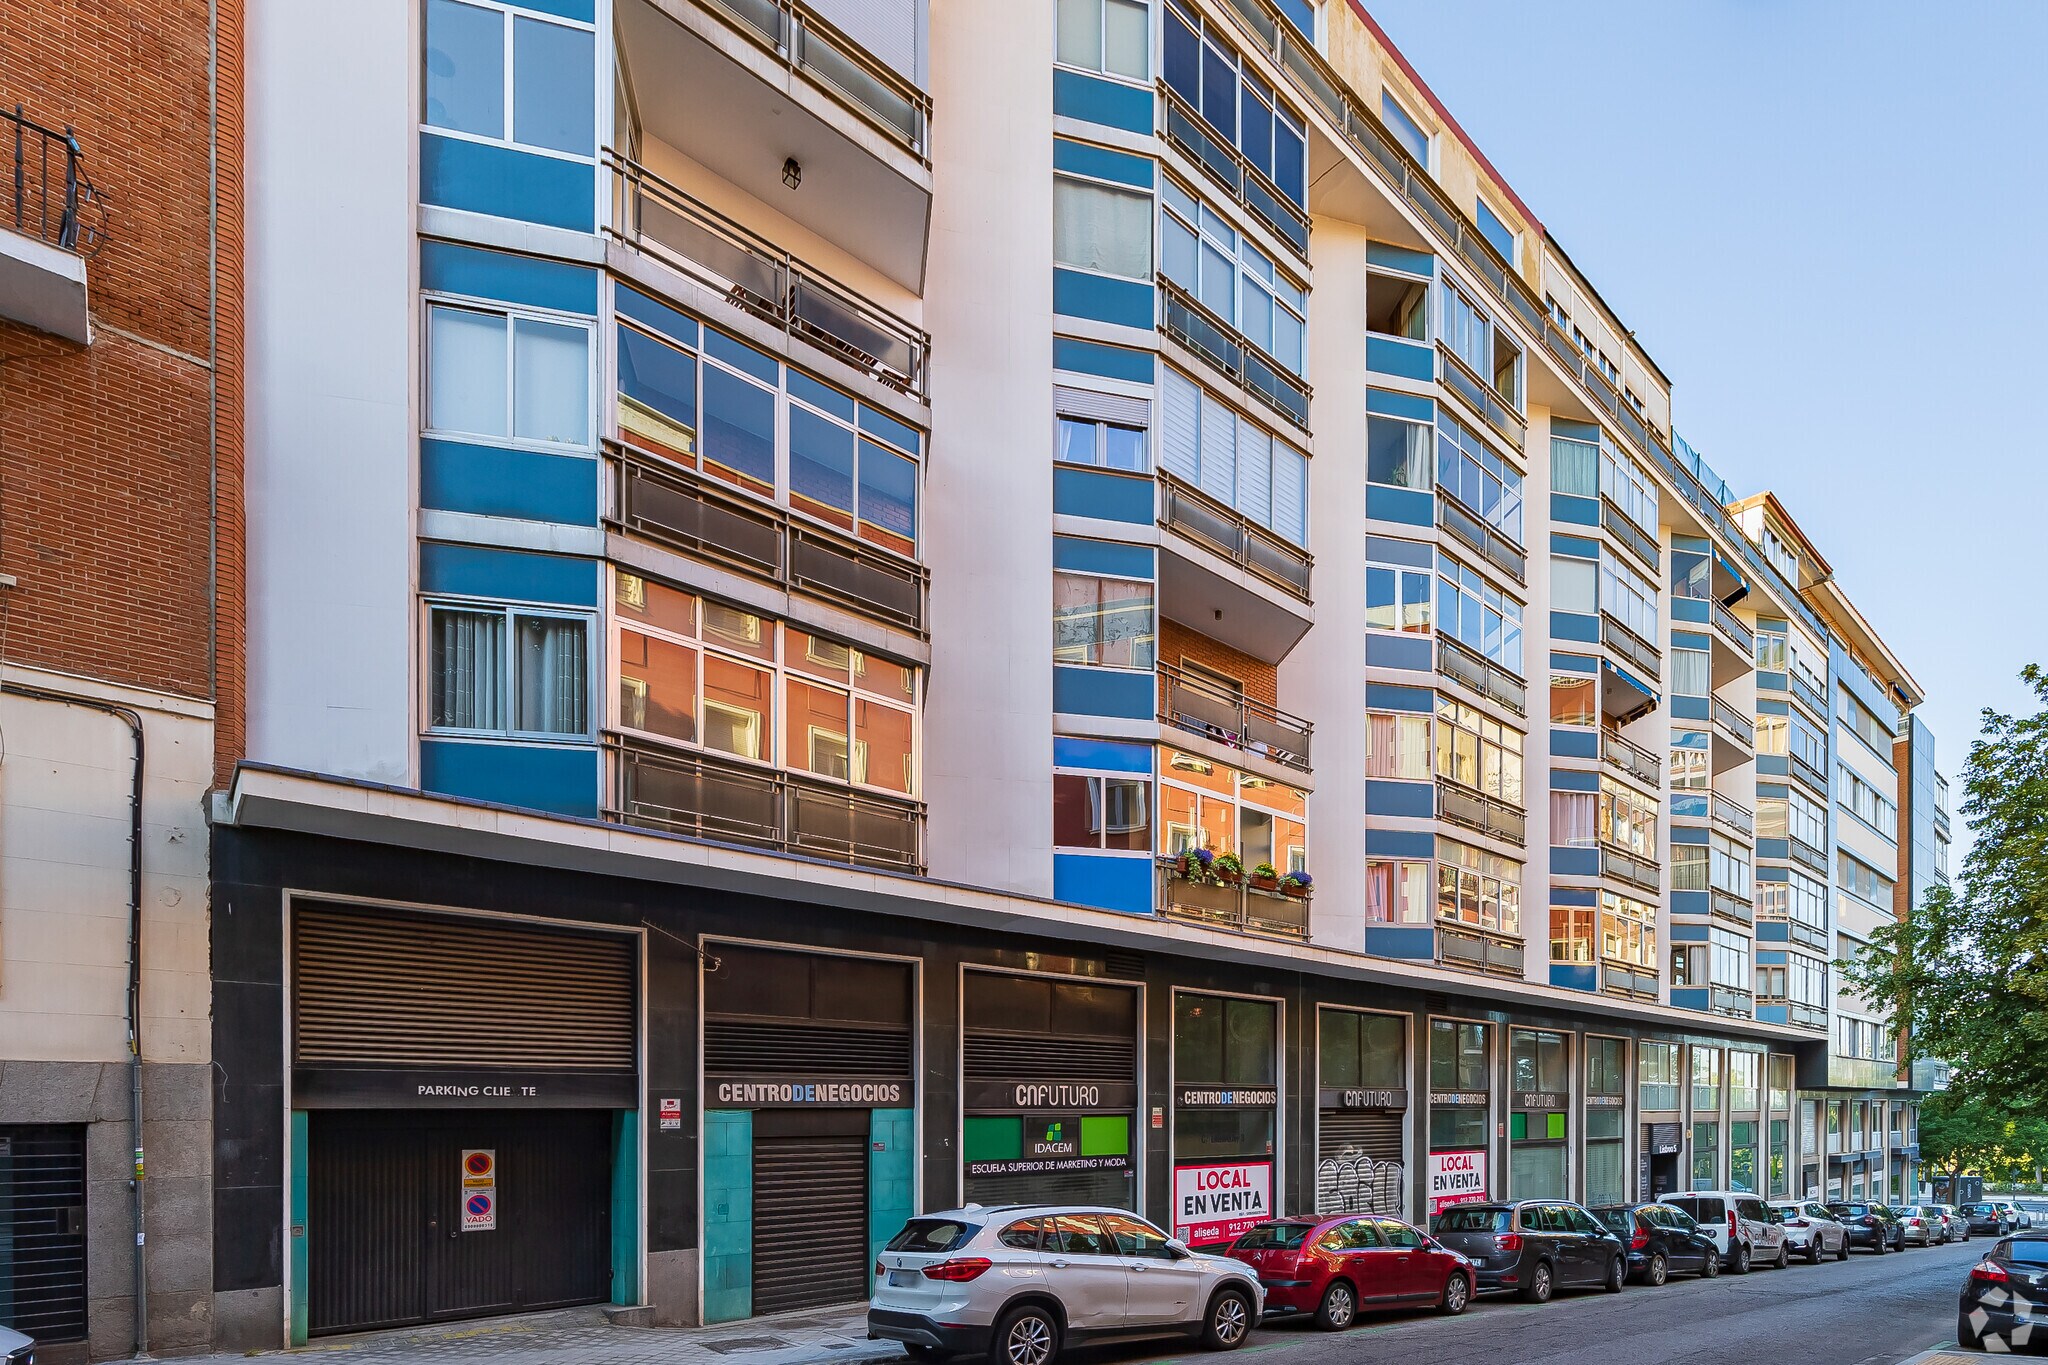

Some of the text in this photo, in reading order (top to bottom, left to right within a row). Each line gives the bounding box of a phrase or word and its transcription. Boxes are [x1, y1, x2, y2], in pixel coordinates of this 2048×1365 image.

[418, 1085, 479, 1097] PARKING
[718, 1083, 900, 1102] CENTRODENEGOCIOS
[1184, 1090, 1277, 1105] CENTRODENEGOCIOS
[1034, 1143, 1073, 1154] IDACEM
[972, 1158, 1127, 1174] ESCUELA SUPERIOR DE MARKETING Y MODA
[1441, 1156, 1474, 1172] LOCAL
[1197, 1169, 1251, 1191] LOCAL
[1434, 1172, 1481, 1191] EN VENTA
[1184, 1190, 1263, 1216] EN VENTA
[465, 1215, 493, 1223] VADO
[1194, 1226, 1220, 1238] aliseda
[1228, 1222, 1241, 1231] 912
[1242, 1220, 1255, 1230] 770
